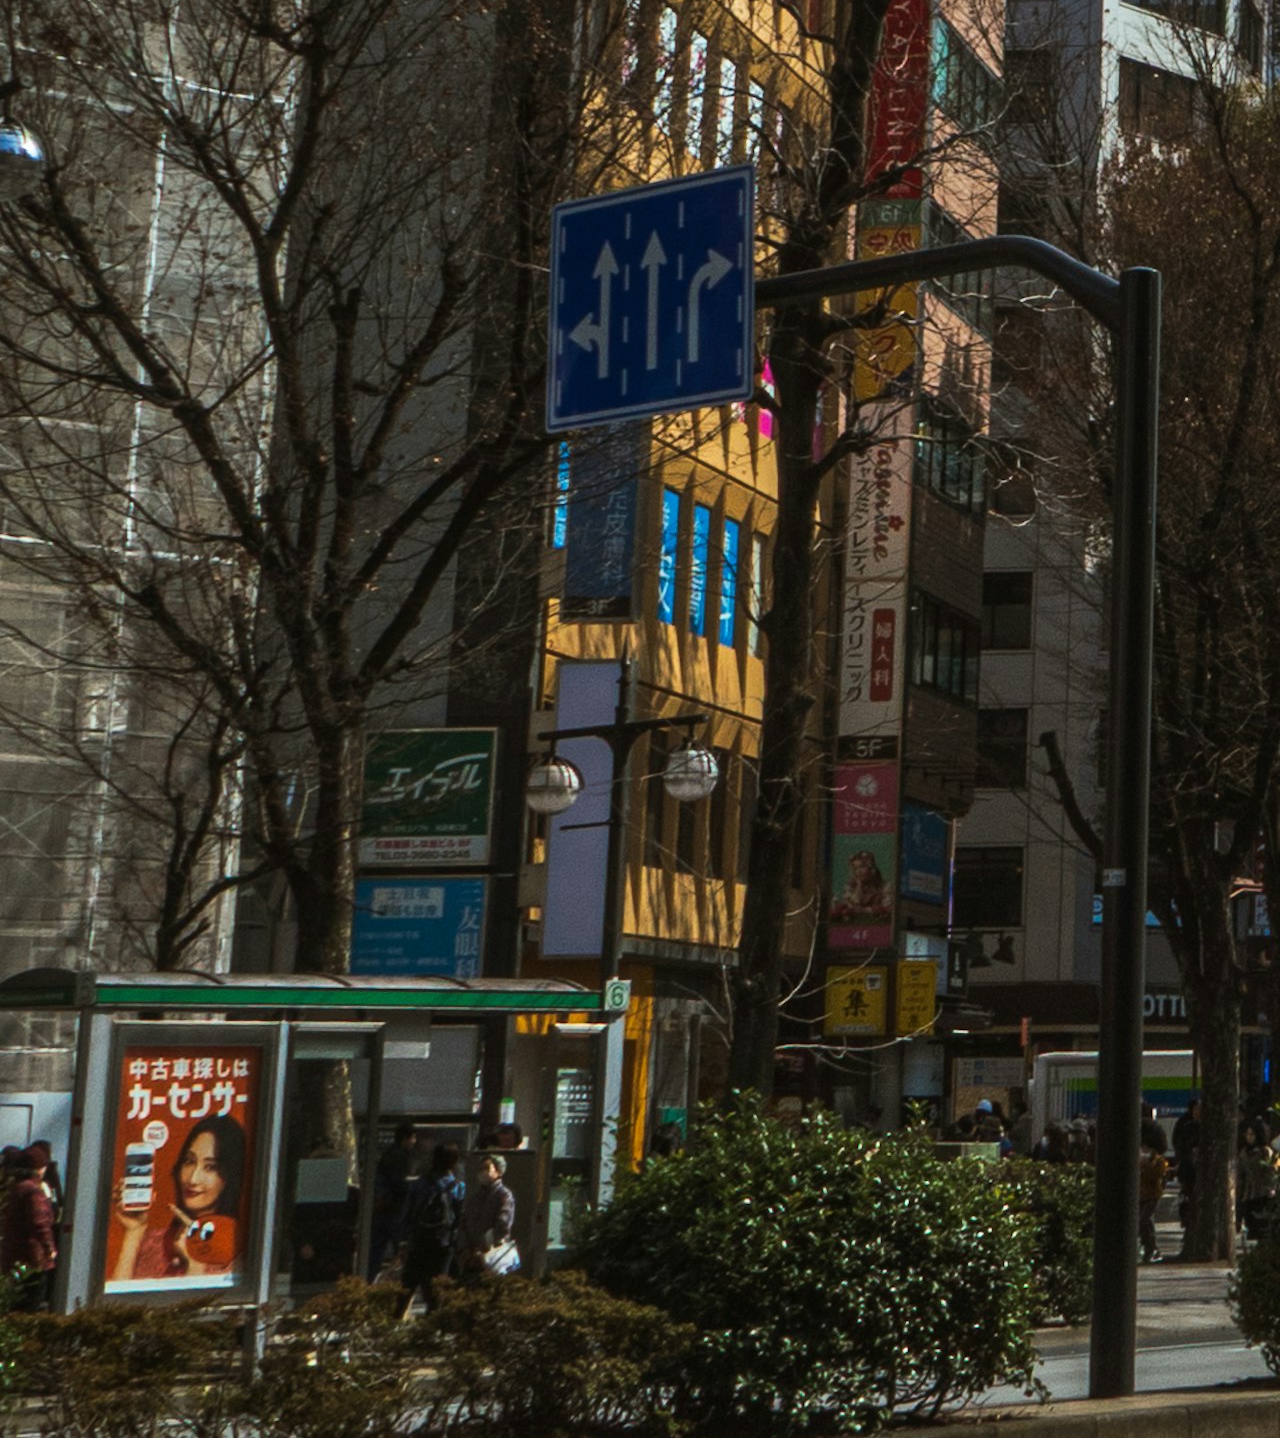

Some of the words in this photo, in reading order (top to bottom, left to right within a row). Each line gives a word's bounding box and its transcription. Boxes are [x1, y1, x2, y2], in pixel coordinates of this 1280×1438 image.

[873, 622, 893, 687] 婦人科
[856, 738, 882, 758] 5F
[611, 983, 625, 1007] 6
[842, 989, 869, 1017] 集
[128, 1057, 250, 1081] 中古車探しは
[126, 1081, 249, 1120] カーセンサー
